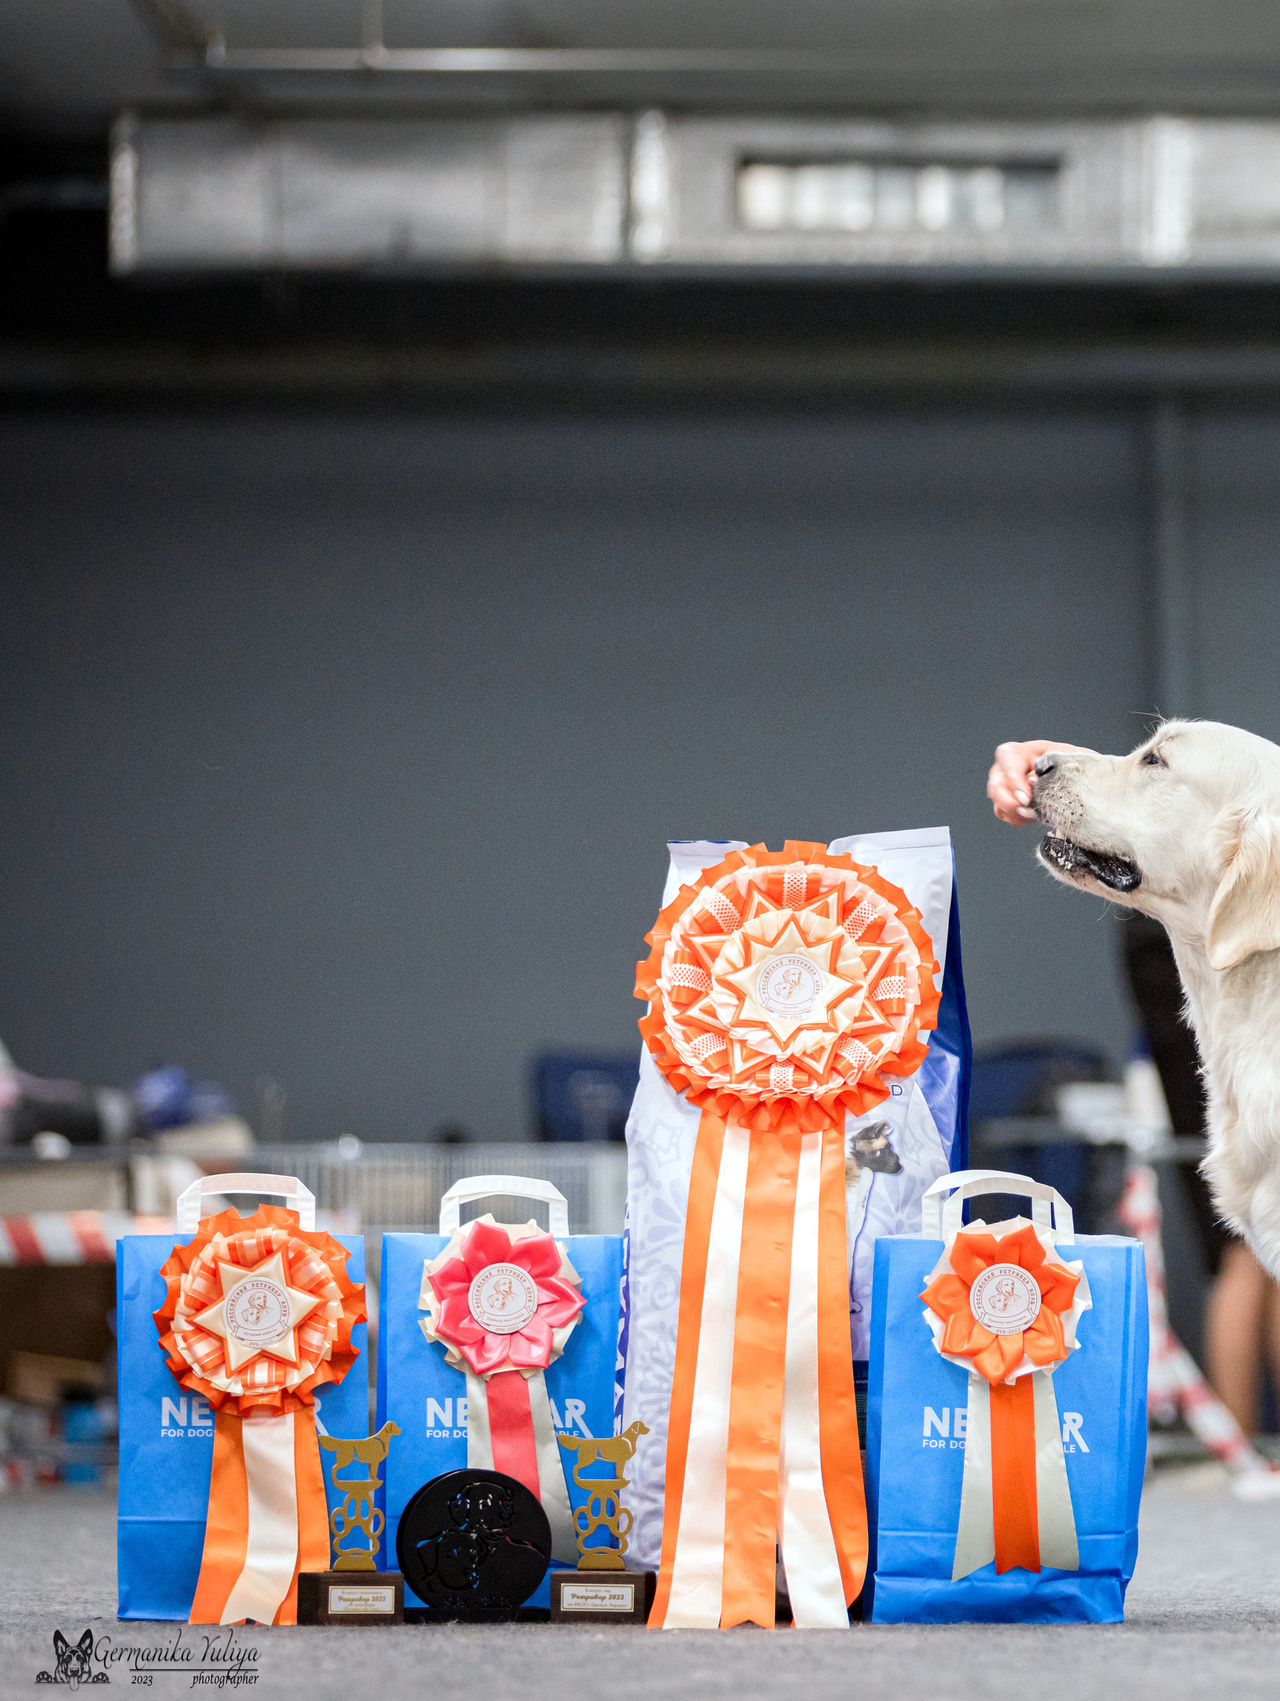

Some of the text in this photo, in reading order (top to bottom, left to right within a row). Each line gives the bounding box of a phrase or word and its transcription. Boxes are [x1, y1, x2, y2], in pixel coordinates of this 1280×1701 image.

[762, 960, 784, 995] РОССИЙСКИЙ
[788, 958, 817, 976] РЕТРИВЕР
[474, 1271, 493, 1309] РОССИЙСКИЙ
[496, 1268, 527, 1283] РЕТРИВЕР
[976, 1272, 995, 1310] РОССИЙСКИЙ
[999, 1269, 1030, 1285] РЕТРИВЕР
[228, 1285, 248, 1323] РОССИЙСКИЙ
[251, 1282, 282, 1297] РЕТРИВЕР
[161, 1429, 215, 1438] FOR DOG
[426, 1430, 468, 1438] FOR DO
[922, 1439, 966, 1449] FOR DO
[571, 1593, 607, 1602] Ретривер
